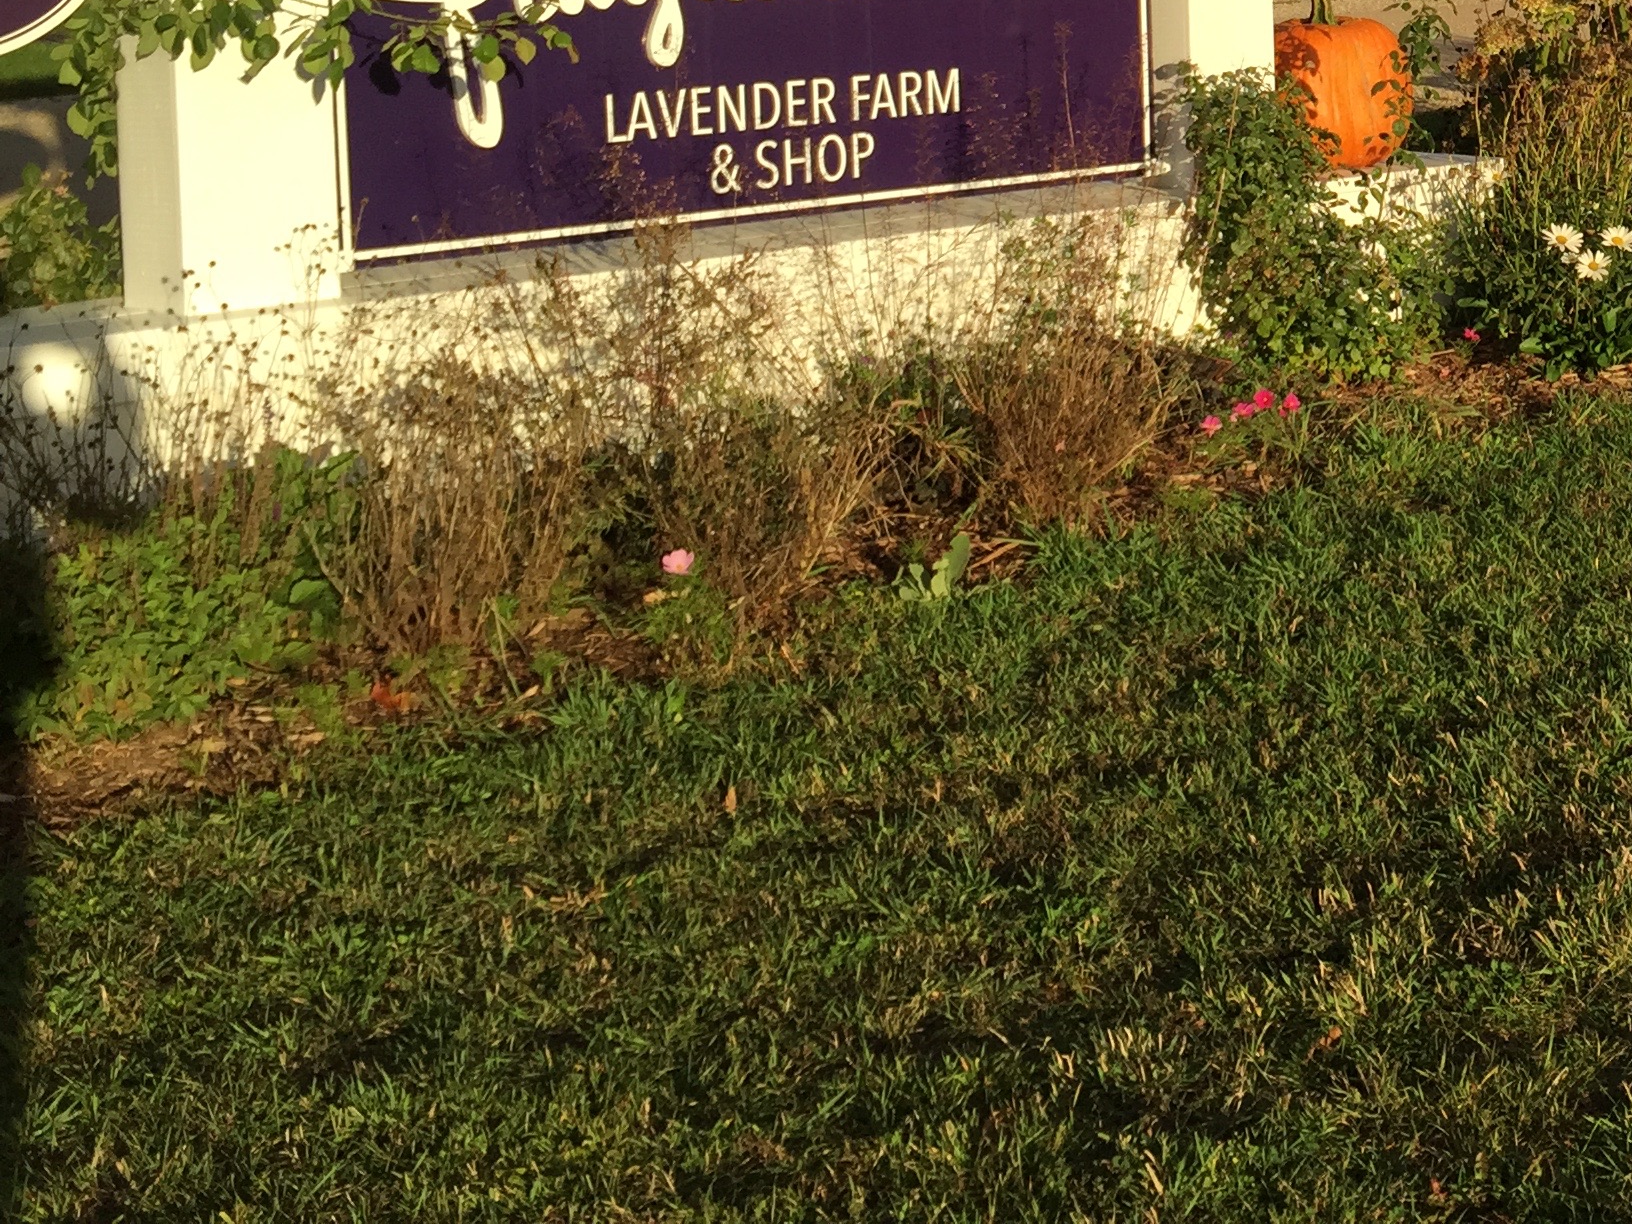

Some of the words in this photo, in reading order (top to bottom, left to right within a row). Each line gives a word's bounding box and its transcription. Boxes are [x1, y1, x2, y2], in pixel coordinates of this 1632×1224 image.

[605, 78, 837, 143] LAVENDER
[851, 68, 961, 122] FARM
[710, 144, 742, 194] &
[755, 131, 875, 191] SHOP
